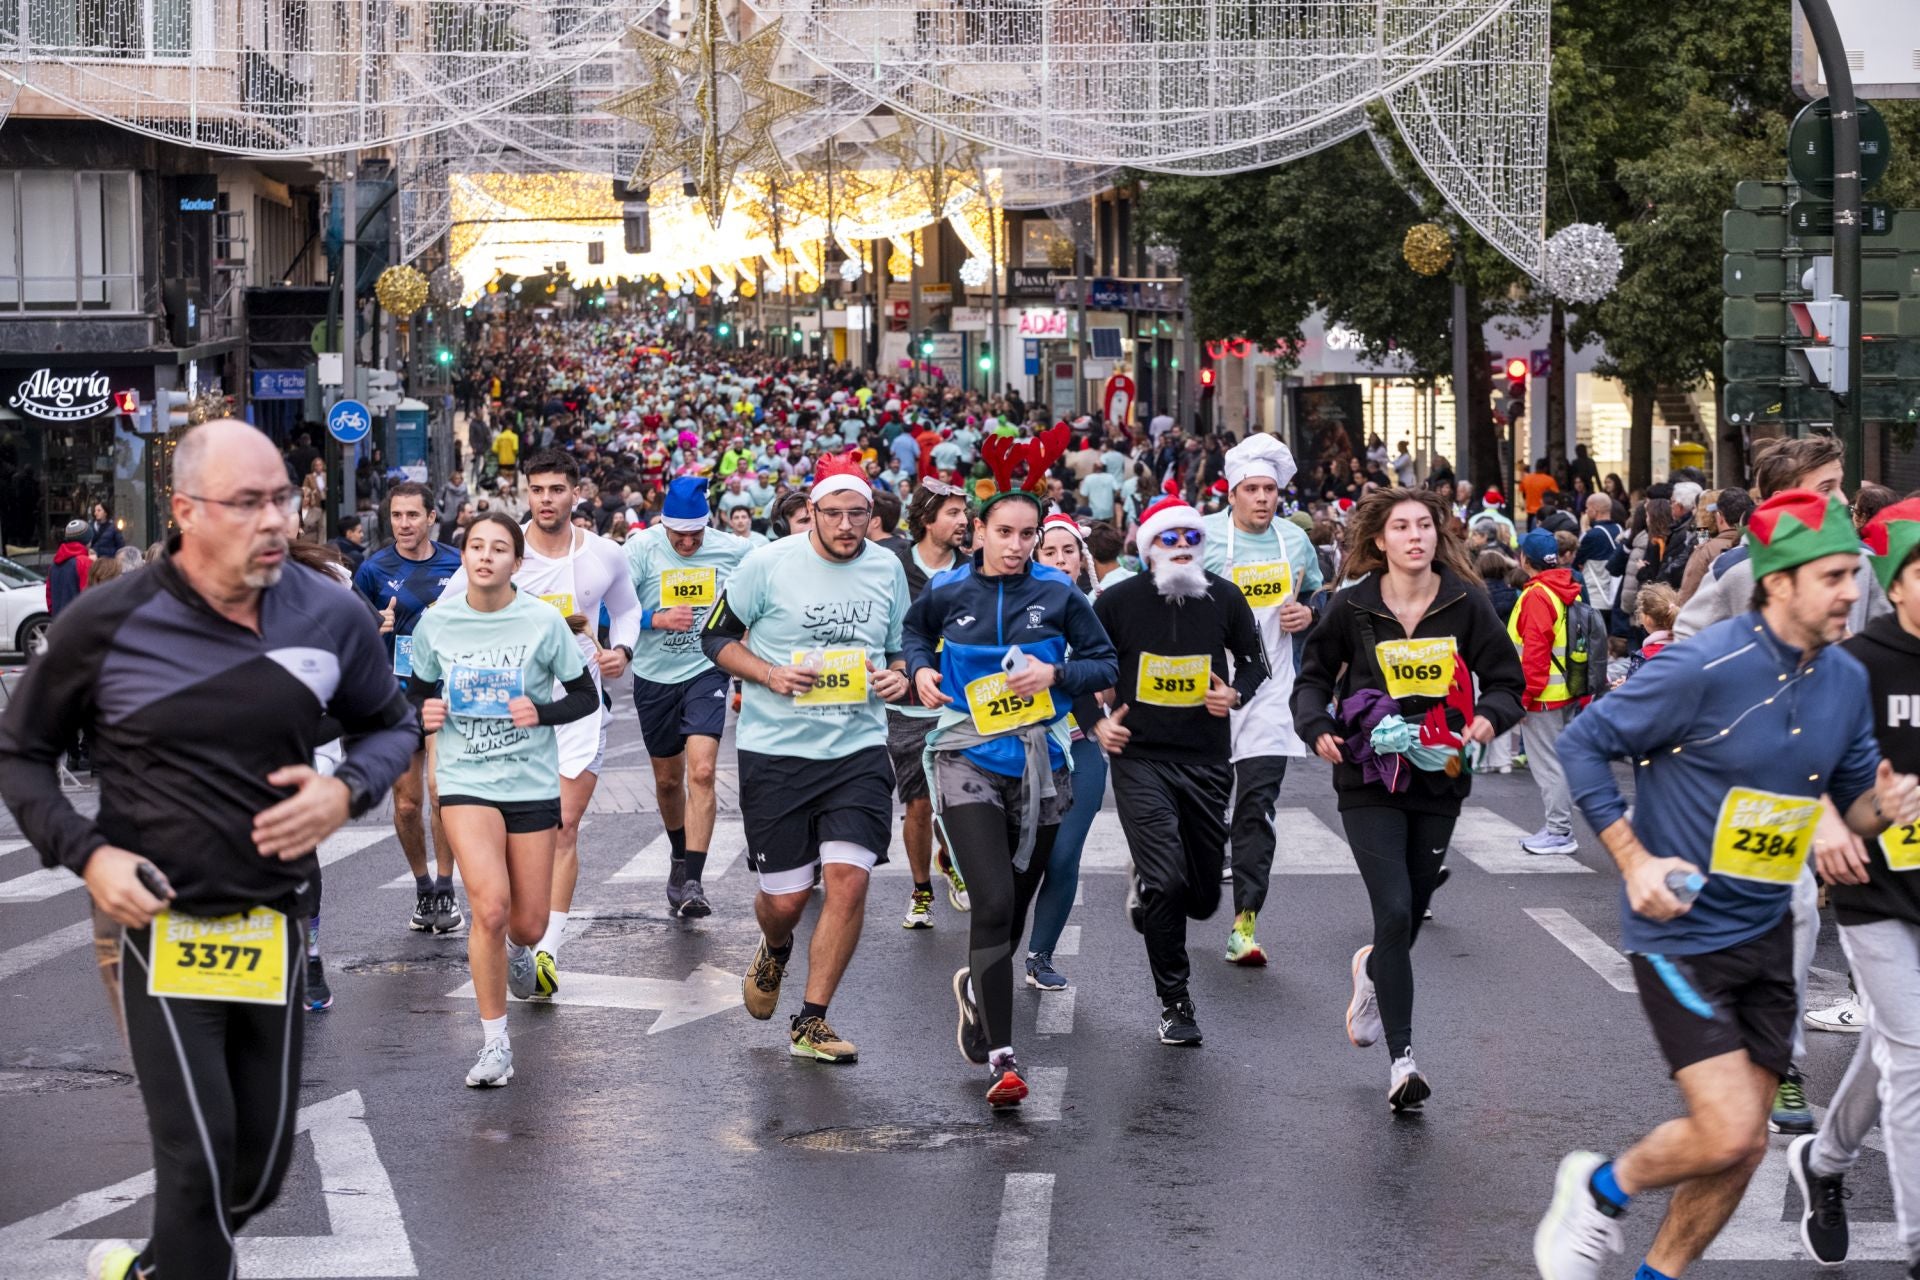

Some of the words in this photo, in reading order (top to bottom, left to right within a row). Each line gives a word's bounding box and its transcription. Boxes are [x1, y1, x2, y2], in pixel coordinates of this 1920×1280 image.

[9, 368, 111, 408] Alegría
[673, 585, 703, 597] 1821
[1243, 582, 1282, 597] 2628
[801, 600, 872, 629] SAN
[1391, 664, 1442, 680] 1069
[1153, 677, 1196, 692] 3813
[461, 688, 511, 703] 3359
[1732, 829, 1798, 859] 2384
[177, 941, 262, 972] 3377
